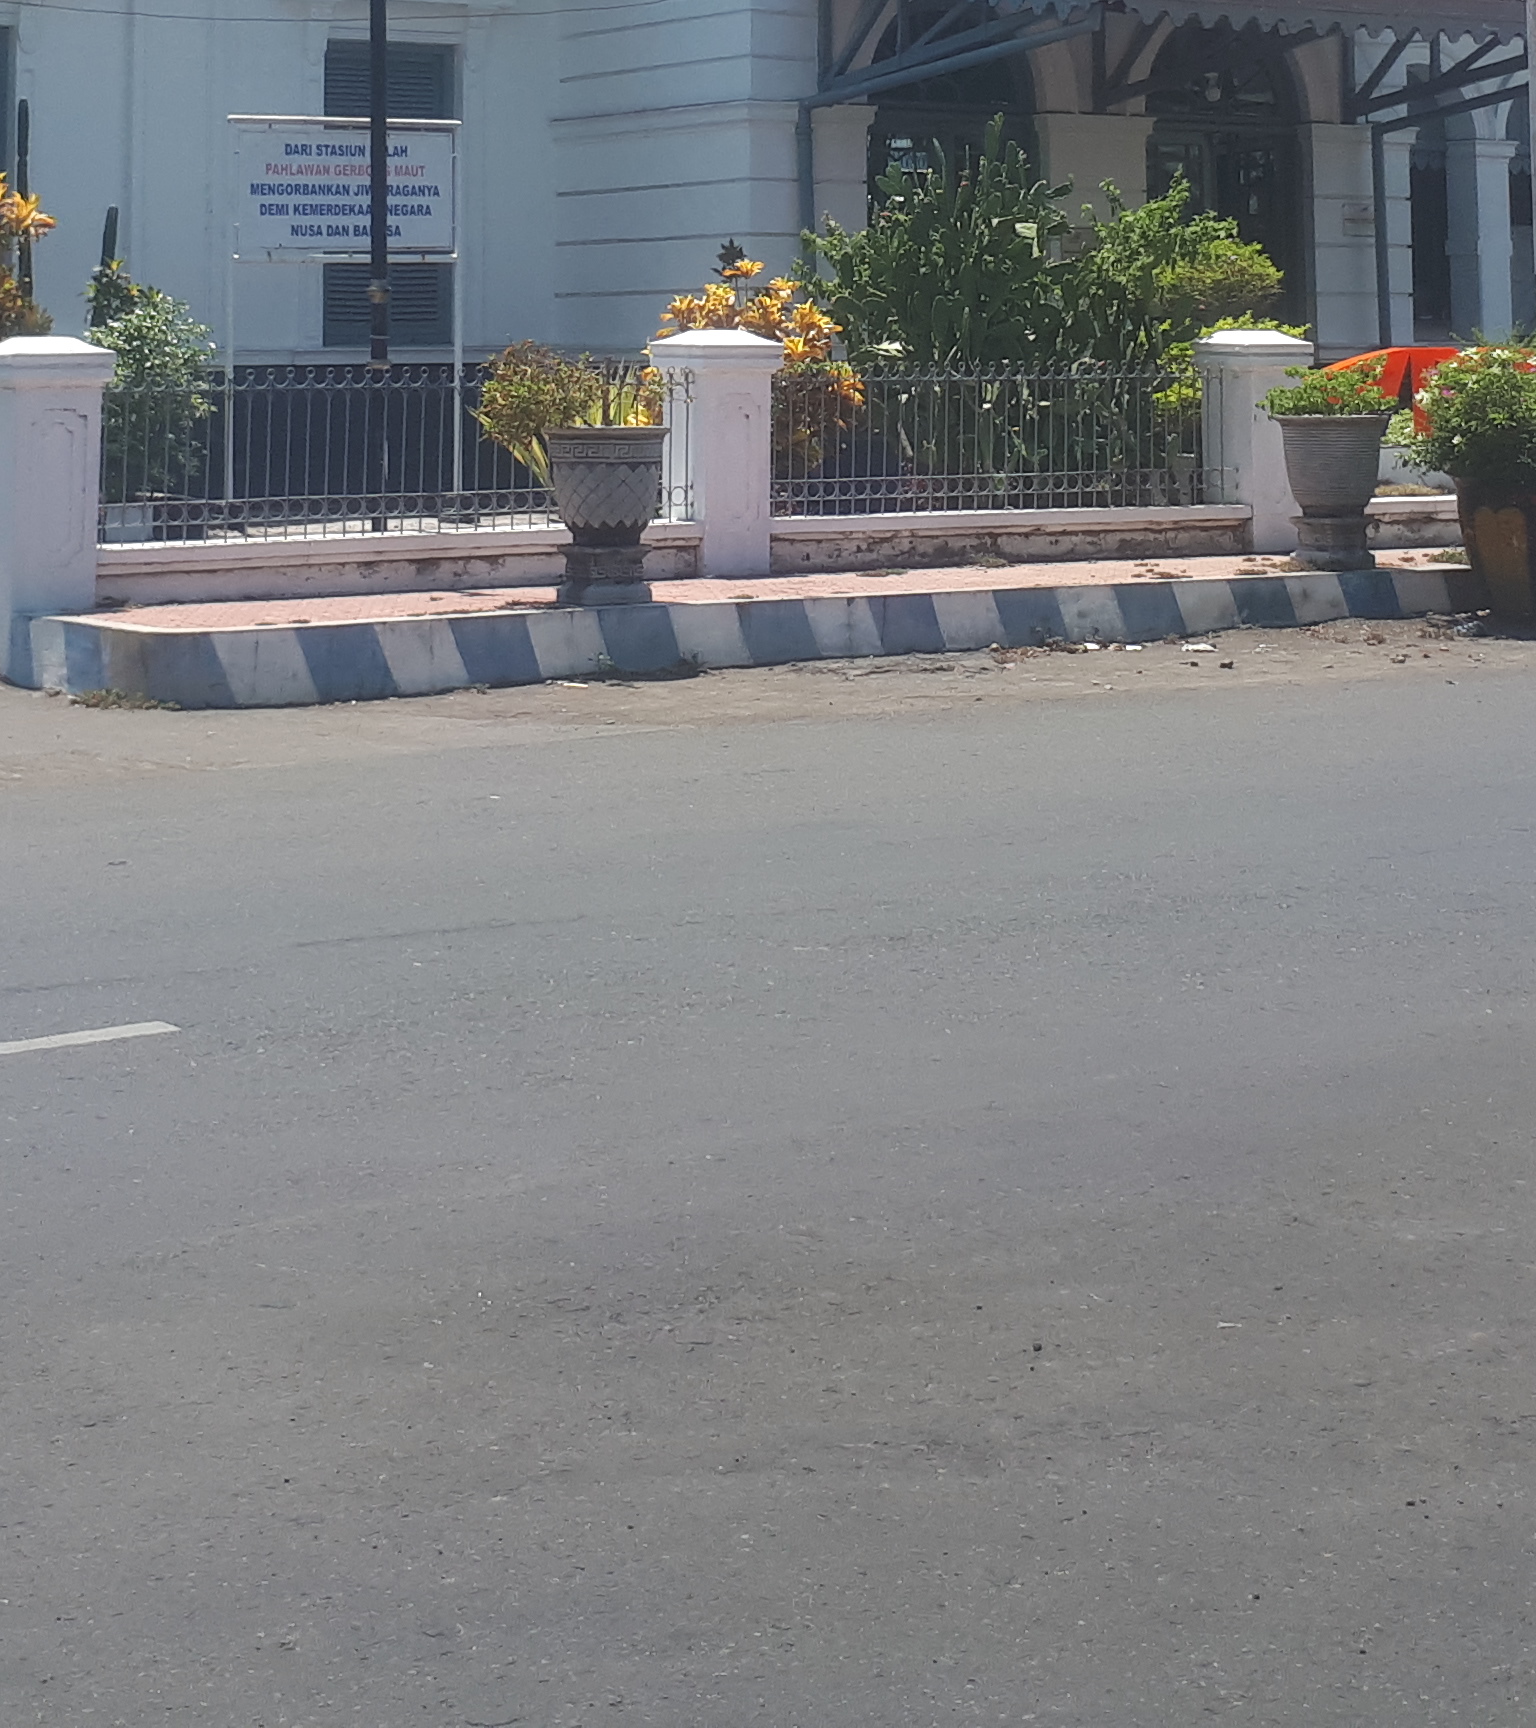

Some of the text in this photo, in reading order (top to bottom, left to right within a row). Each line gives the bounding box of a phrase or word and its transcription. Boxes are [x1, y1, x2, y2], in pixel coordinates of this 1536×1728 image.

[284, 143, 312, 156] DARI
[316, 144, 365, 157] STASIUN
[265, 163, 426, 177] PAHLAWAN GERBOG MAUT
[250, 183, 350, 196] MENGORBANKAN
[259, 203, 289, 216] DEMI
[293, 203, 383, 216] KEMERDEKAA
[291, 224, 401, 237] NUSA DAN BASA
